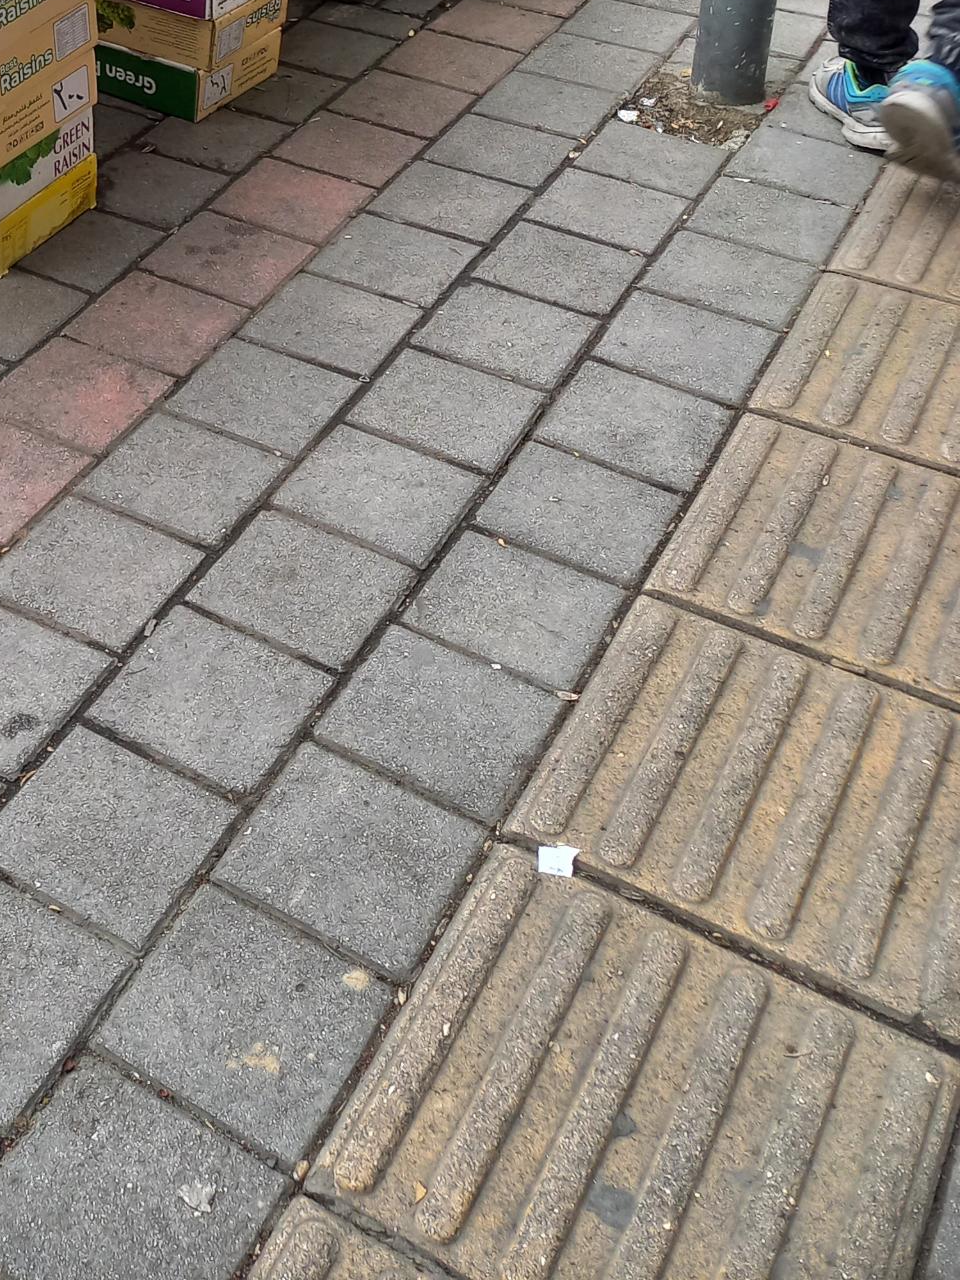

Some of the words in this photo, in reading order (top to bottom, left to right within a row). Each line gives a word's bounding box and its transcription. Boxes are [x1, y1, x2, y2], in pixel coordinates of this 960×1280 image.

[0, 56, 18, 76] Best
[0, 48, 54, 97] Raisins
[105, 62, 157, 96] Green
[54, 116, 90, 155] GREEN
[54, 137, 91, 178] RAISIN
